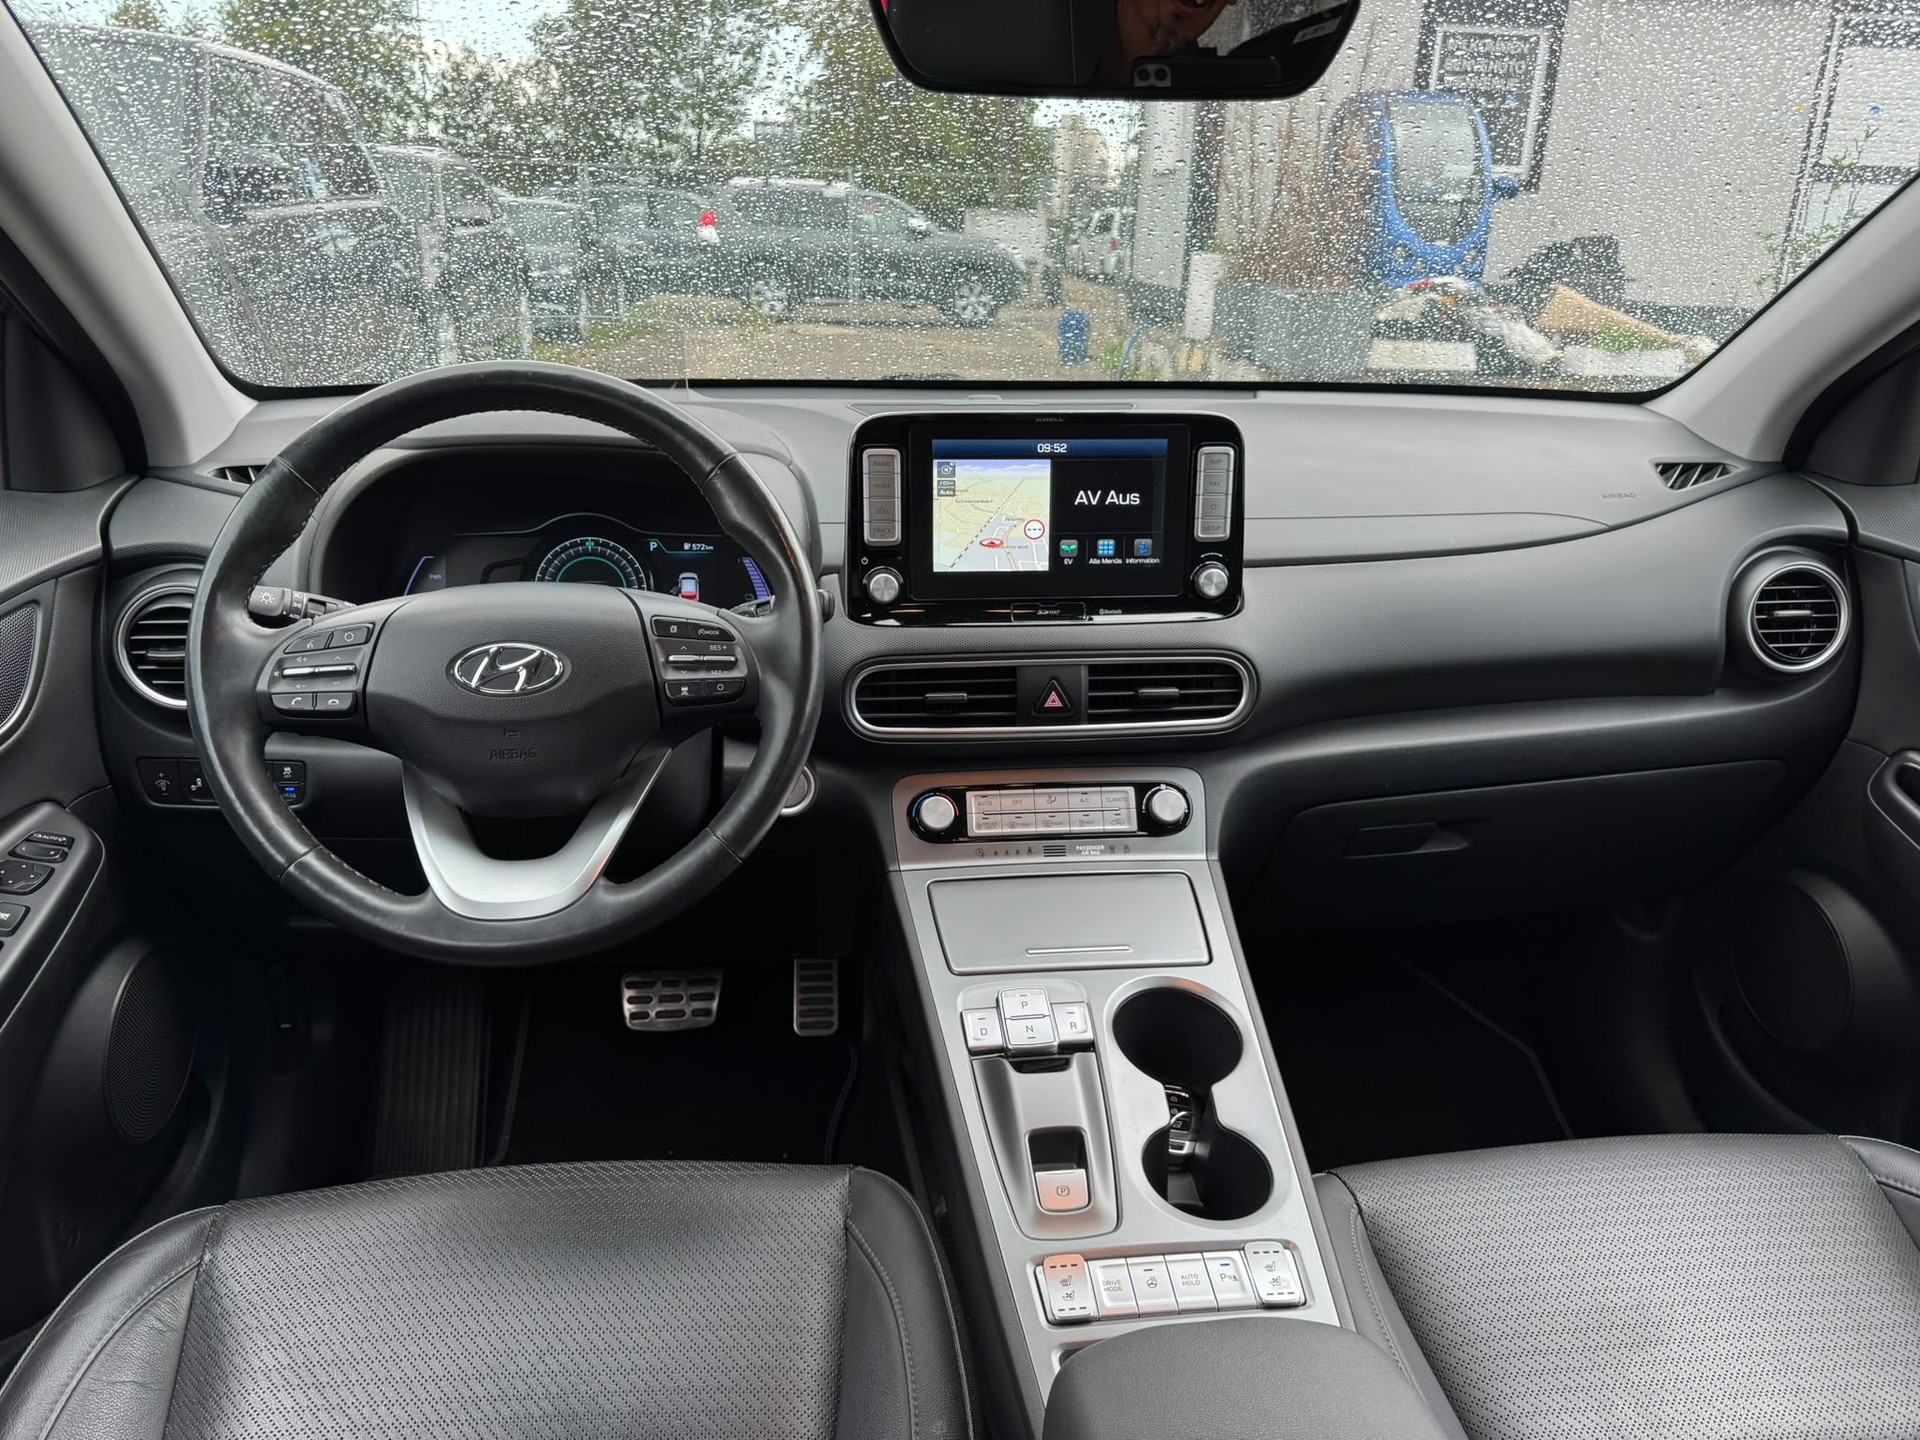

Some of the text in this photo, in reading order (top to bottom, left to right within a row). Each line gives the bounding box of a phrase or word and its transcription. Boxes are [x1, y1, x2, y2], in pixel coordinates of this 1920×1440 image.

[1037, 443, 1068, 453] 09:52
[1074, 490, 1141, 506] AV Aus
[650, 541, 658, 552] P
[489, 748, 537, 760] AIRBAG
[1021, 1001, 1028, 1009] P
[1026, 1025, 1034, 1033] N
[1070, 1022, 1078, 1030] R
[980, 1028, 988, 1036] D
